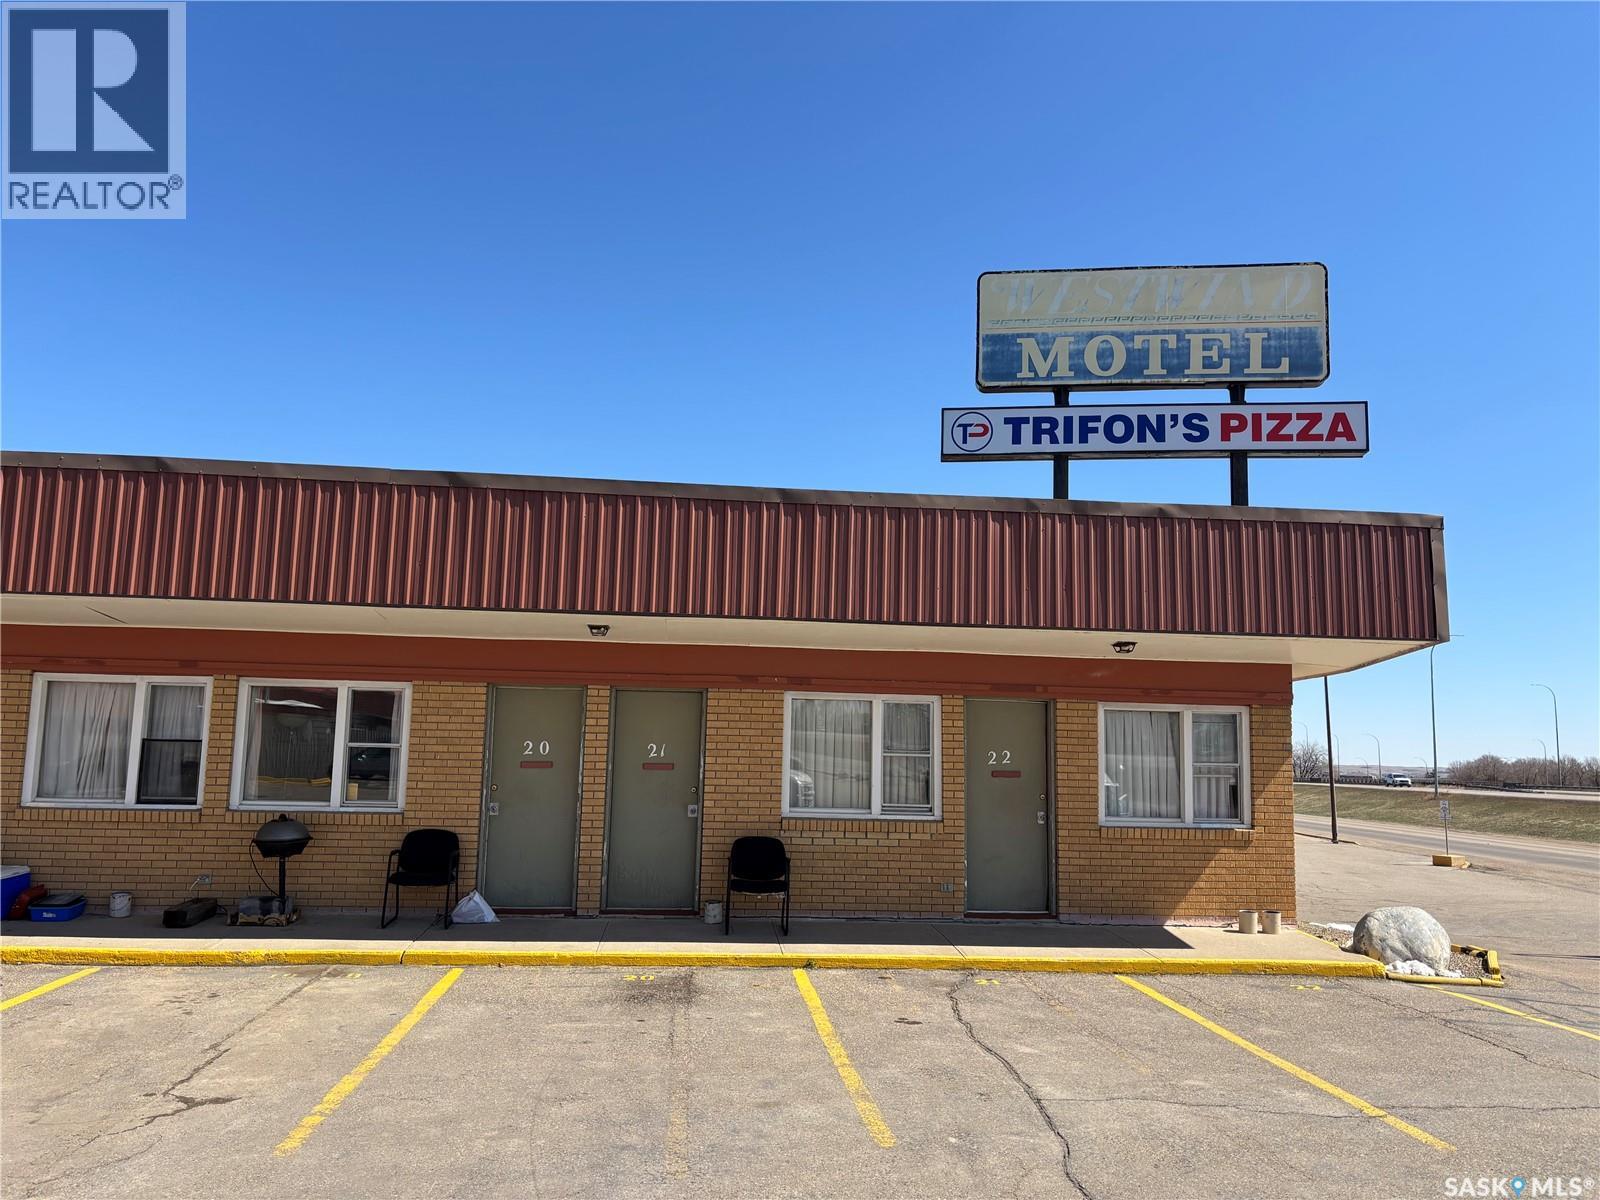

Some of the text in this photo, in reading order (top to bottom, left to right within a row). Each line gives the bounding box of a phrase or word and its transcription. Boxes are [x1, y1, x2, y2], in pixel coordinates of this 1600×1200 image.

[1016, 331, 1290, 379] MOTEL
[1003, 411, 1357, 446] TRIFON'S PIZZA
[522, 740, 550, 756] 20
[647, 743, 666, 758] 21
[987, 750, 1012, 765] 22
